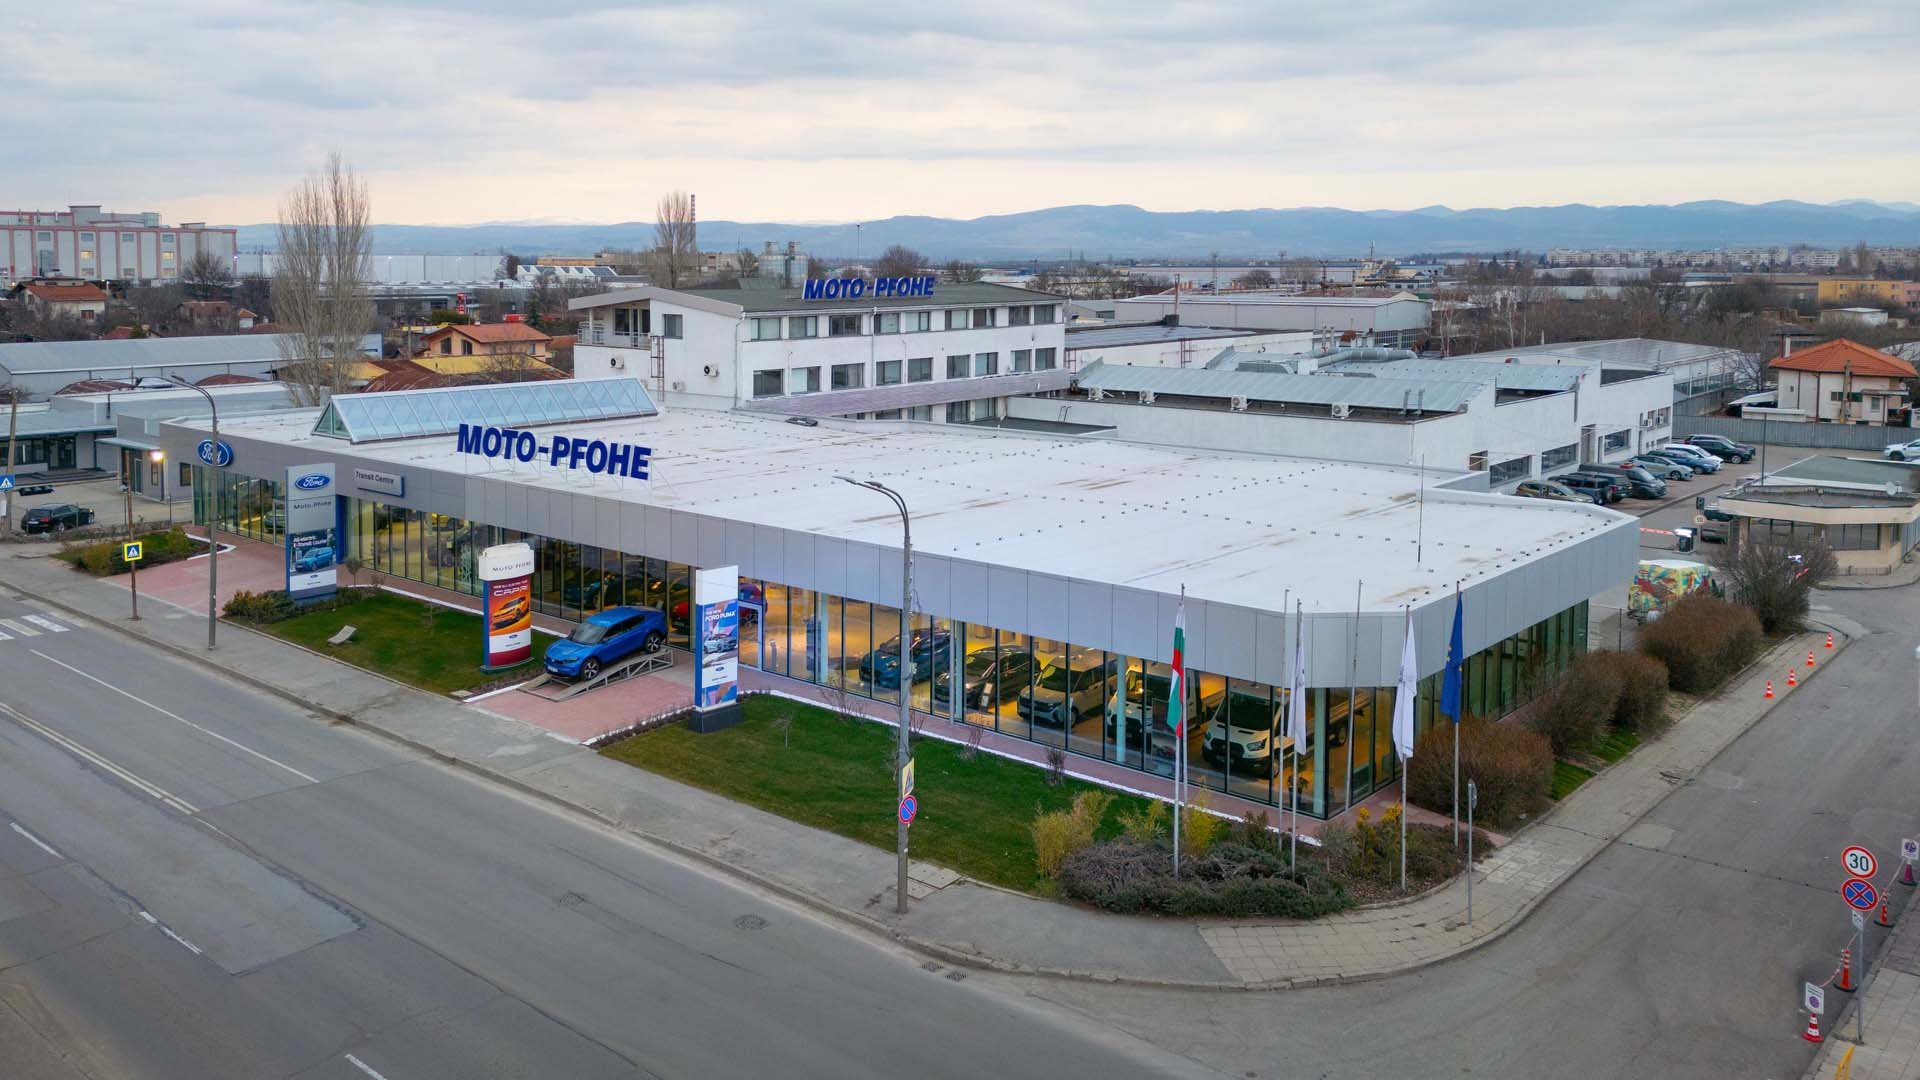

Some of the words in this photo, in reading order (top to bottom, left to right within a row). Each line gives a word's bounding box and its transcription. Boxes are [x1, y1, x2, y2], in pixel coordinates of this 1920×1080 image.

[802, 276, 935, 300] MOTO-PFOHE
[457, 423, 651, 480] MOTO-PFOHE
[355, 470, 375, 481] Transit
[1849, 853, 1869, 872] 30
